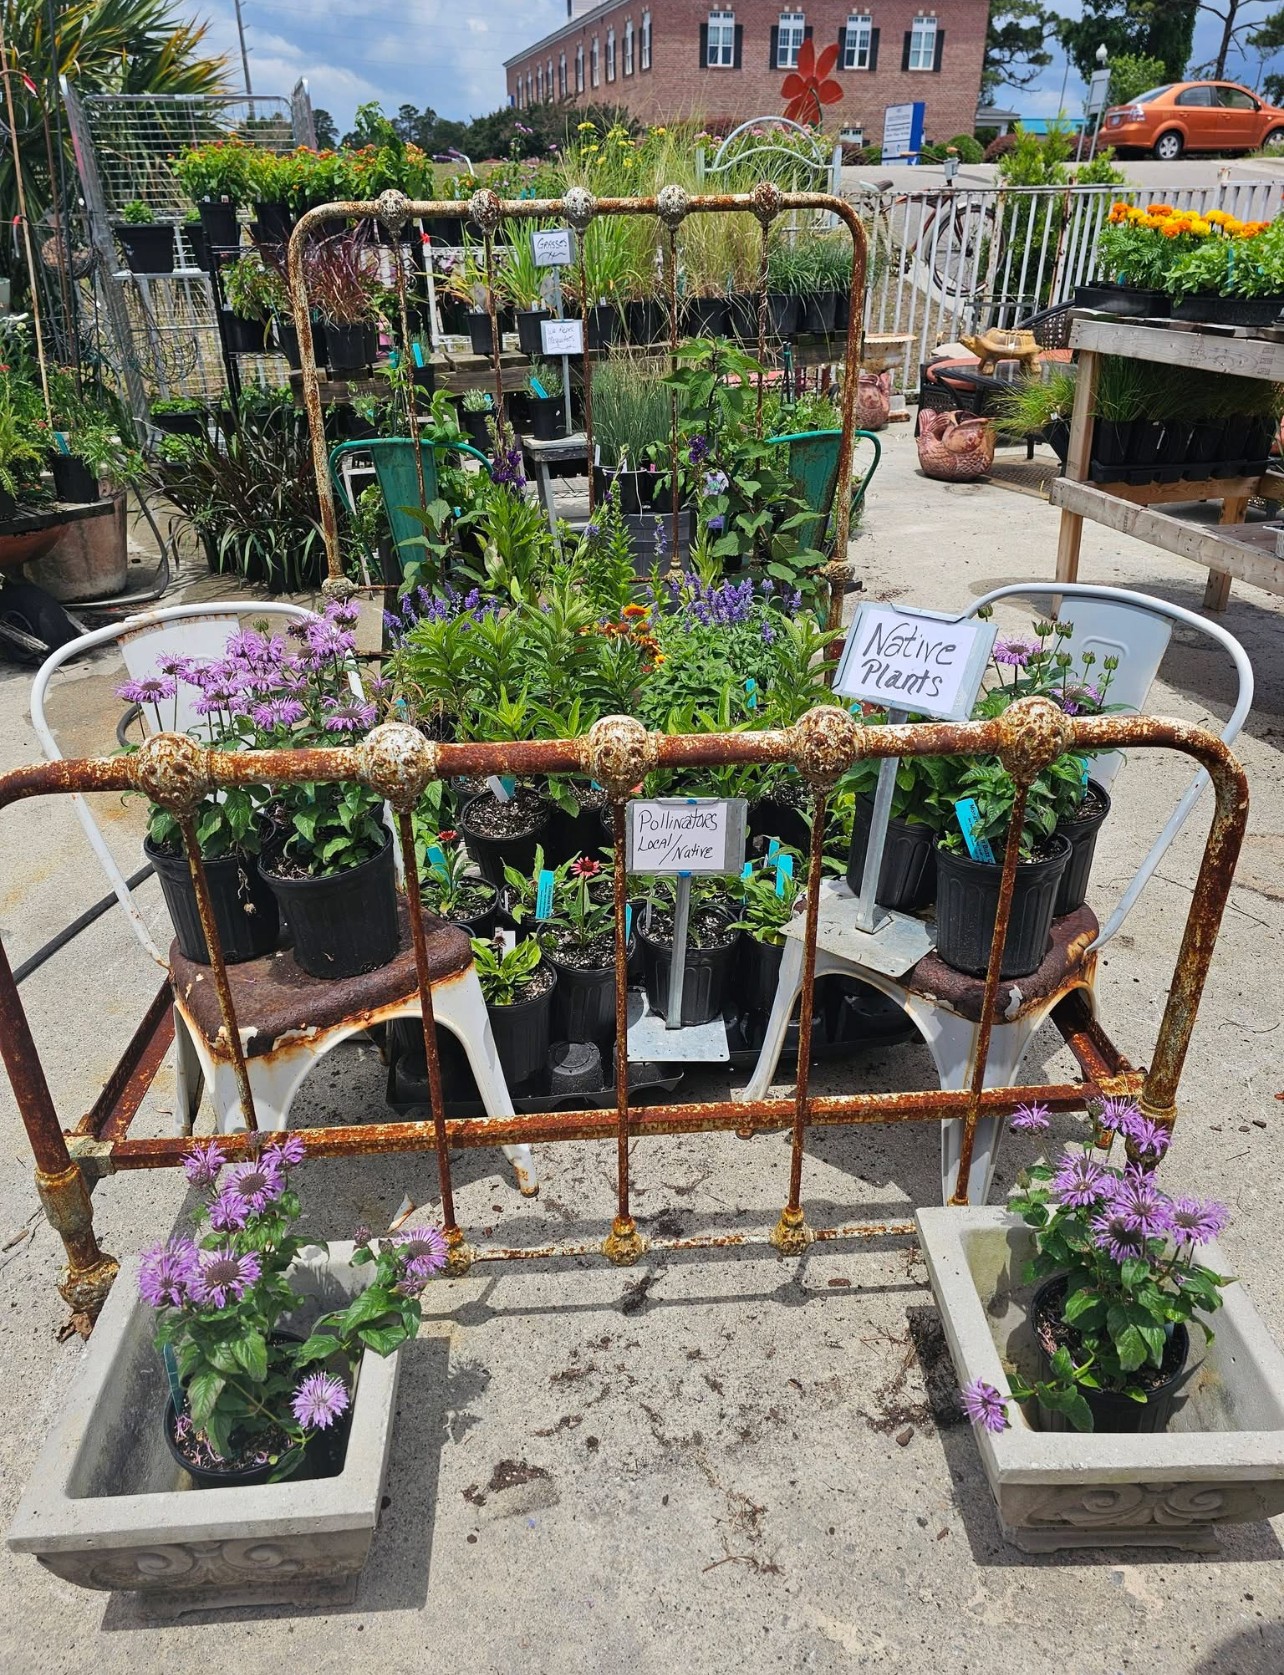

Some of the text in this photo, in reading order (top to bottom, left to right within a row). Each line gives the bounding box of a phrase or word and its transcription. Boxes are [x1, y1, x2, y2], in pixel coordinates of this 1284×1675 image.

[862, 622, 957, 665] Native
[861, 658, 944, 697] Plants
[639, 808, 718, 833] Pollinators
